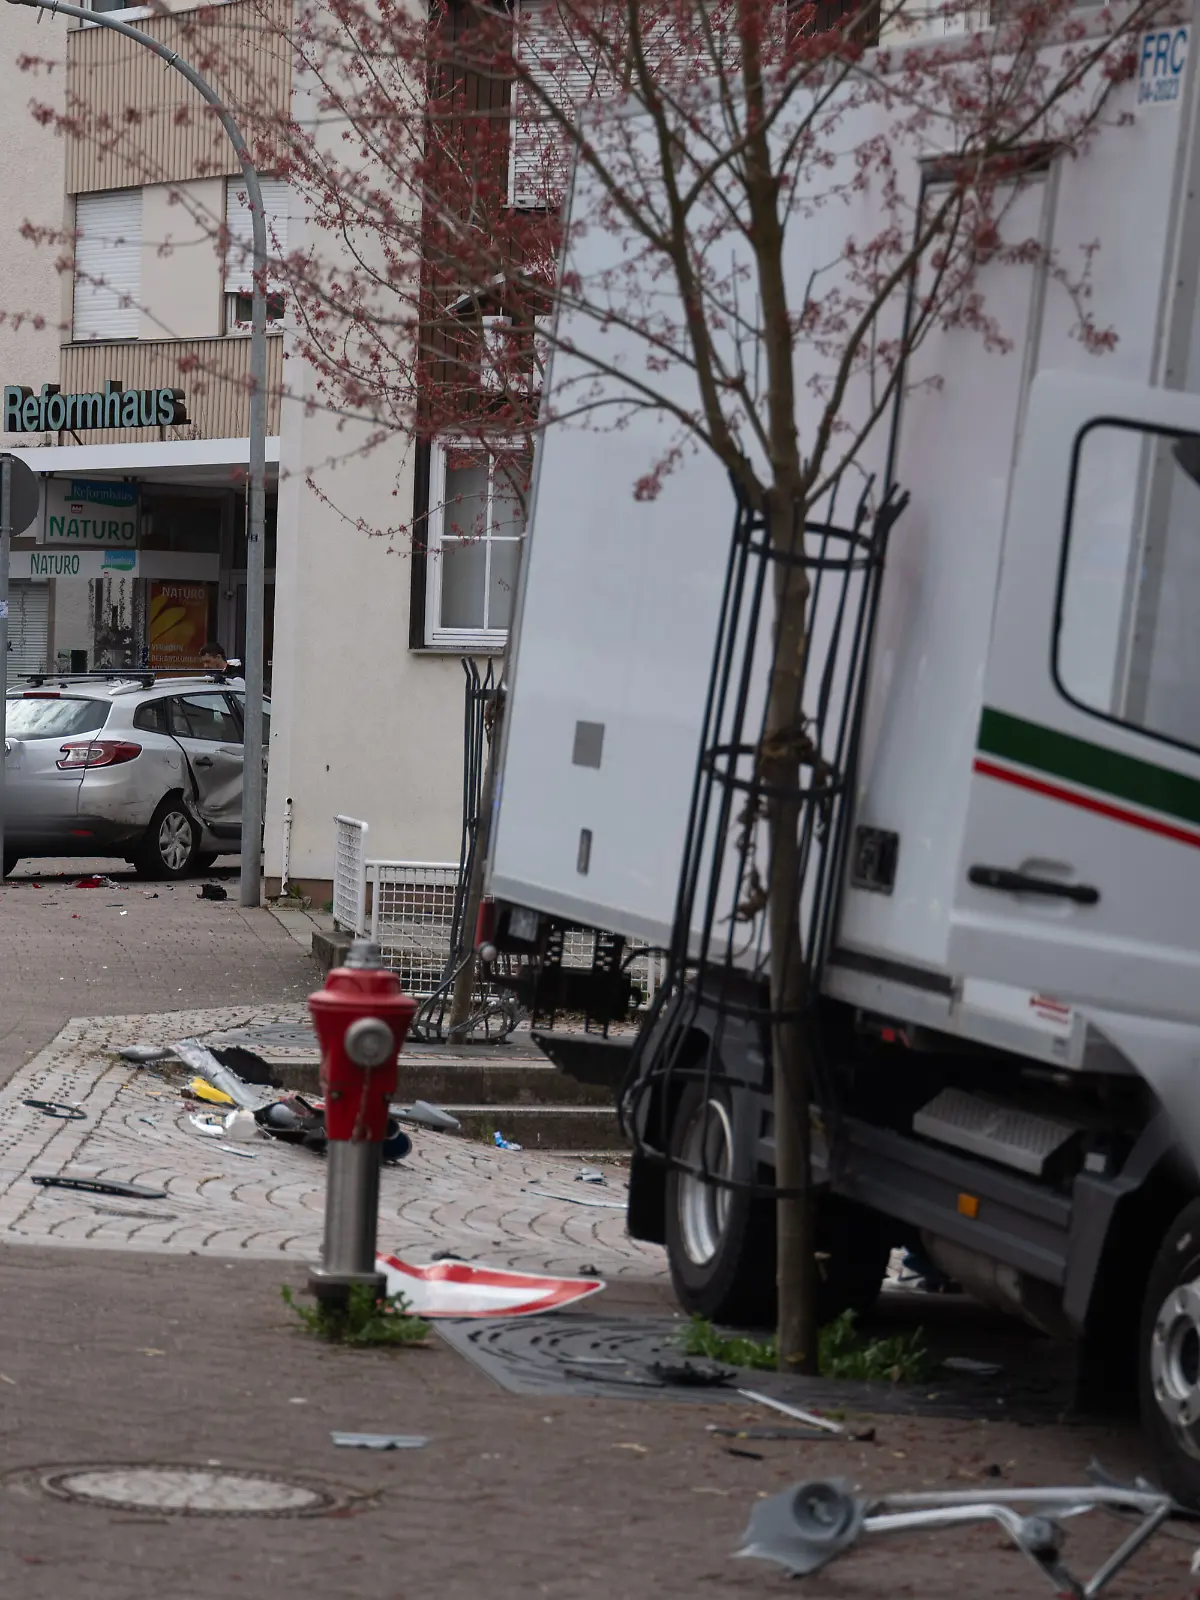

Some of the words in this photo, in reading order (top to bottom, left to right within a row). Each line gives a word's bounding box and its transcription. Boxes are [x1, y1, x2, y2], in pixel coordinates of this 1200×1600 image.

[1140, 28, 1187, 77] FRC
[4, 380, 182, 432] Reformhaus
[73, 485, 133, 501] Reformhaus
[49, 516, 136, 541] NATURO
[30, 553, 80, 575] NATURO
[161, 586, 205, 600] NATURO
